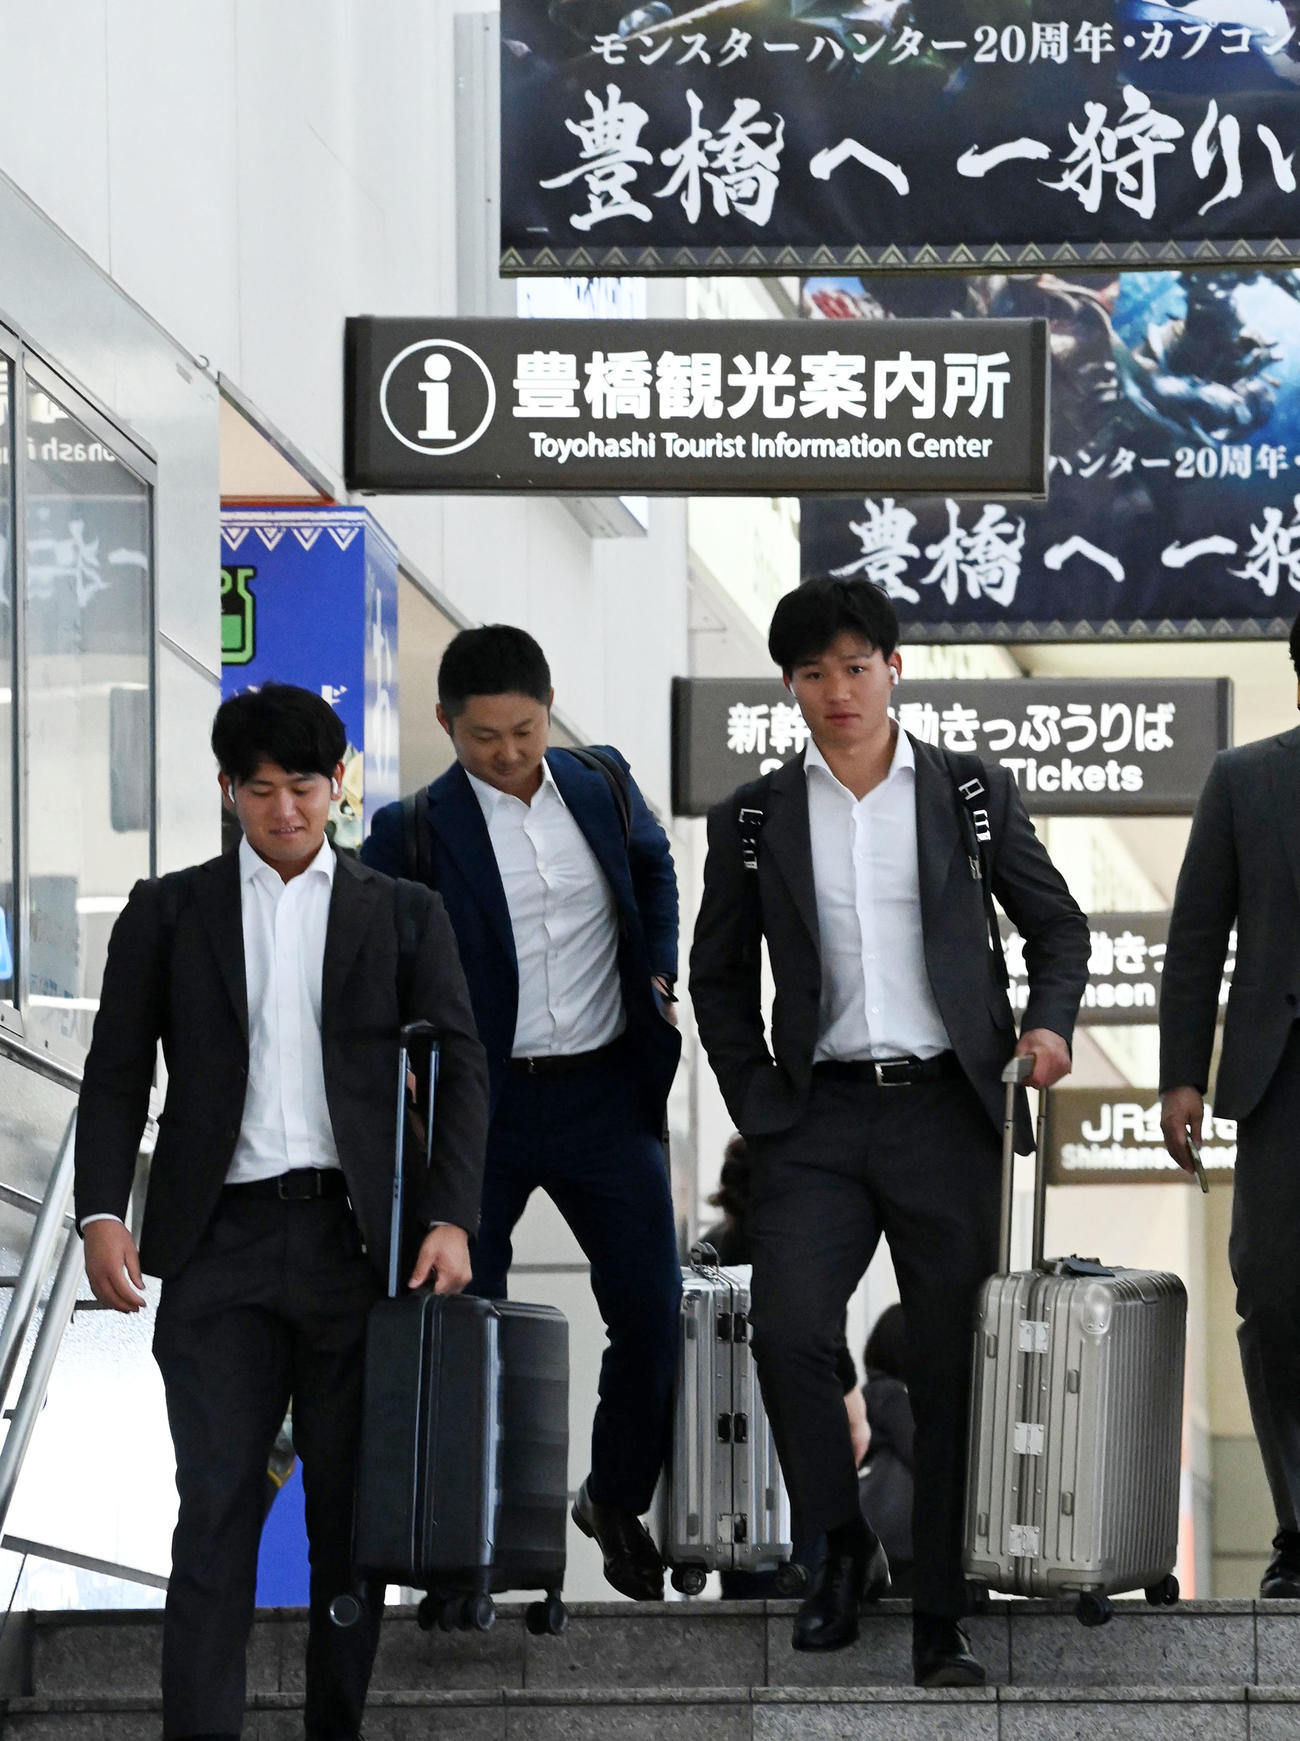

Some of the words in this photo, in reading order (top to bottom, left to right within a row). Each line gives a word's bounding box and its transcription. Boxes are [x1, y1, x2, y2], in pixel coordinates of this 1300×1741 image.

[590, 20, 1300, 67] モンスターハンター20周年・カプコン
[512, 350, 1011, 419] 豊橋観光案内所
[529, 431, 656, 464] Toyohashi
[660, 432, 746, 458] Tourist
[751, 431, 902, 458] Information
[907, 432, 993, 458] Center
[727, 702, 1176, 754] 新幹動きっぷうりば
[999, 757, 1144, 791] Tickets
